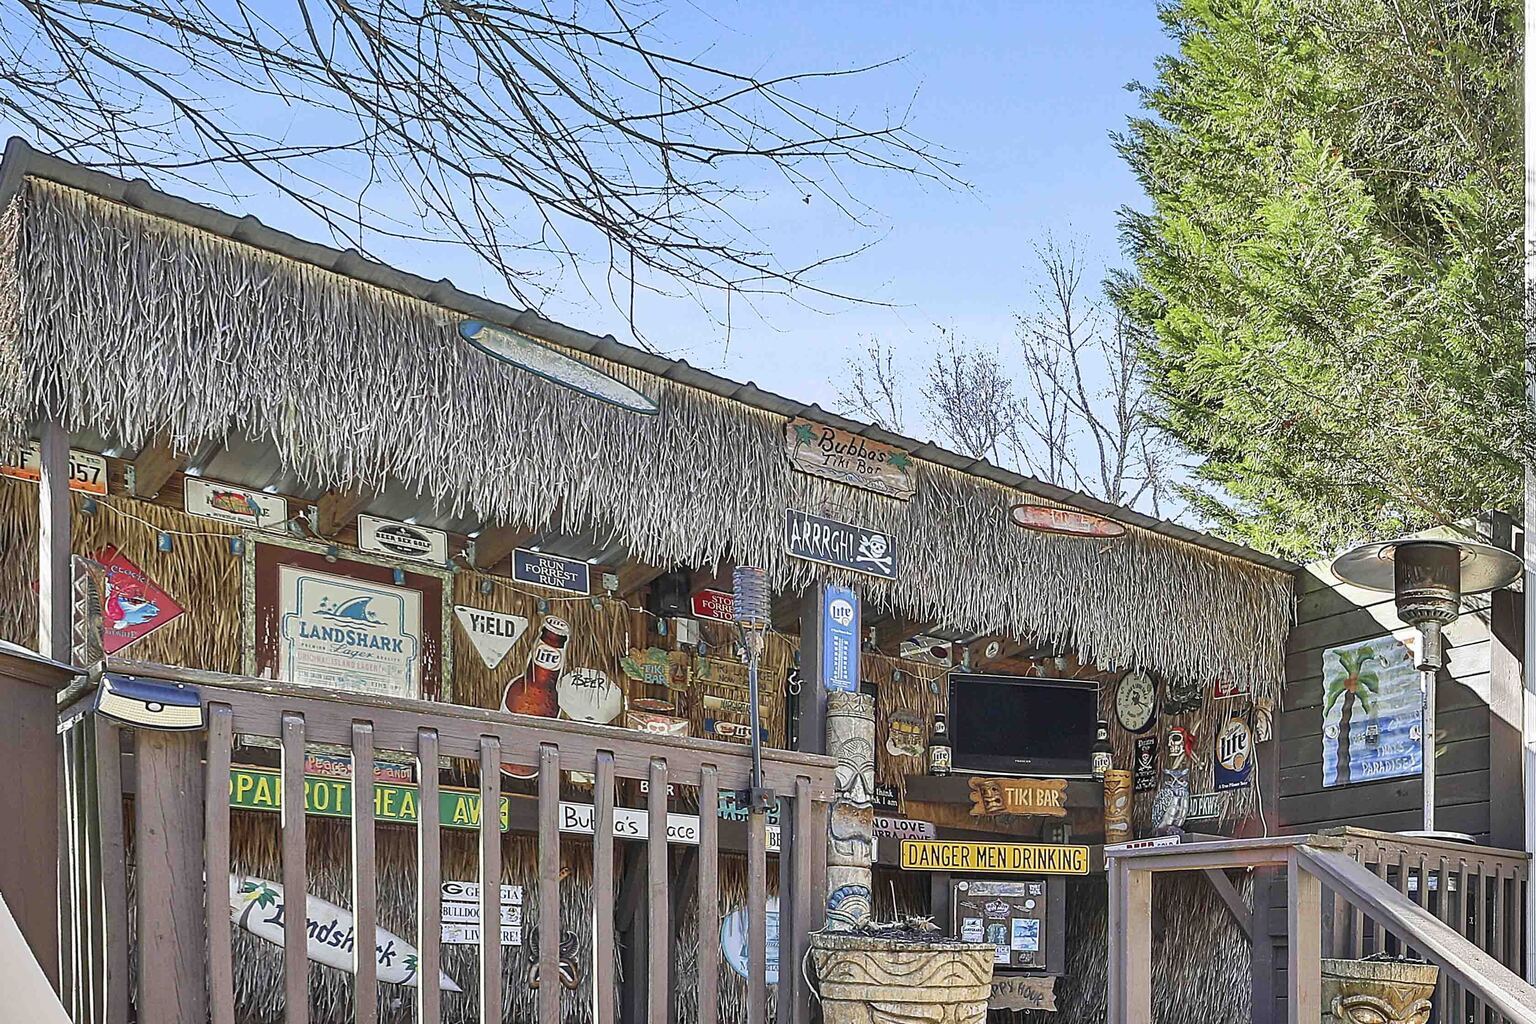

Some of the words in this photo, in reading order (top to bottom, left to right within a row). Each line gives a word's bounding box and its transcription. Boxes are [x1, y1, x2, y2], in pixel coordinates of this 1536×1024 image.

[818, 427, 887, 463] Bubba's
[821, 452, 849, 469] Tiki
[856, 459, 881, 474] Bar
[375, 532, 396, 541] BEER
[790, 518, 854, 563] ARRRGH!
[525, 563, 579, 582] FORREST
[539, 558, 565, 571] RUN
[539, 574, 566, 588] RUN
[702, 600, 736, 613] FORRE
[711, 594, 735, 606] STO
[712, 610, 735, 621] STO
[831, 605, 851, 620] Lite
[469, 613, 515, 639] YIELD
[299, 621, 403, 653] LANDSHARK
[329, 643, 374, 660] Lager
[571, 673, 606, 691] BEER
[237, 774, 346, 814] PAOT
[374, 788, 417, 819] HEA
[640, 781, 674, 796] BR
[1005, 787, 1033, 806] TIKI
[1036, 788, 1060, 807] BAR
[564, 806, 639, 835] Bua's
[894, 820, 926, 833] LOVE
[909, 844, 970, 867] DANGER
[976, 846, 1007, 869] MEN
[1012, 847, 1082, 871] DRINKING
[443, 906, 504, 918] BULLDO
